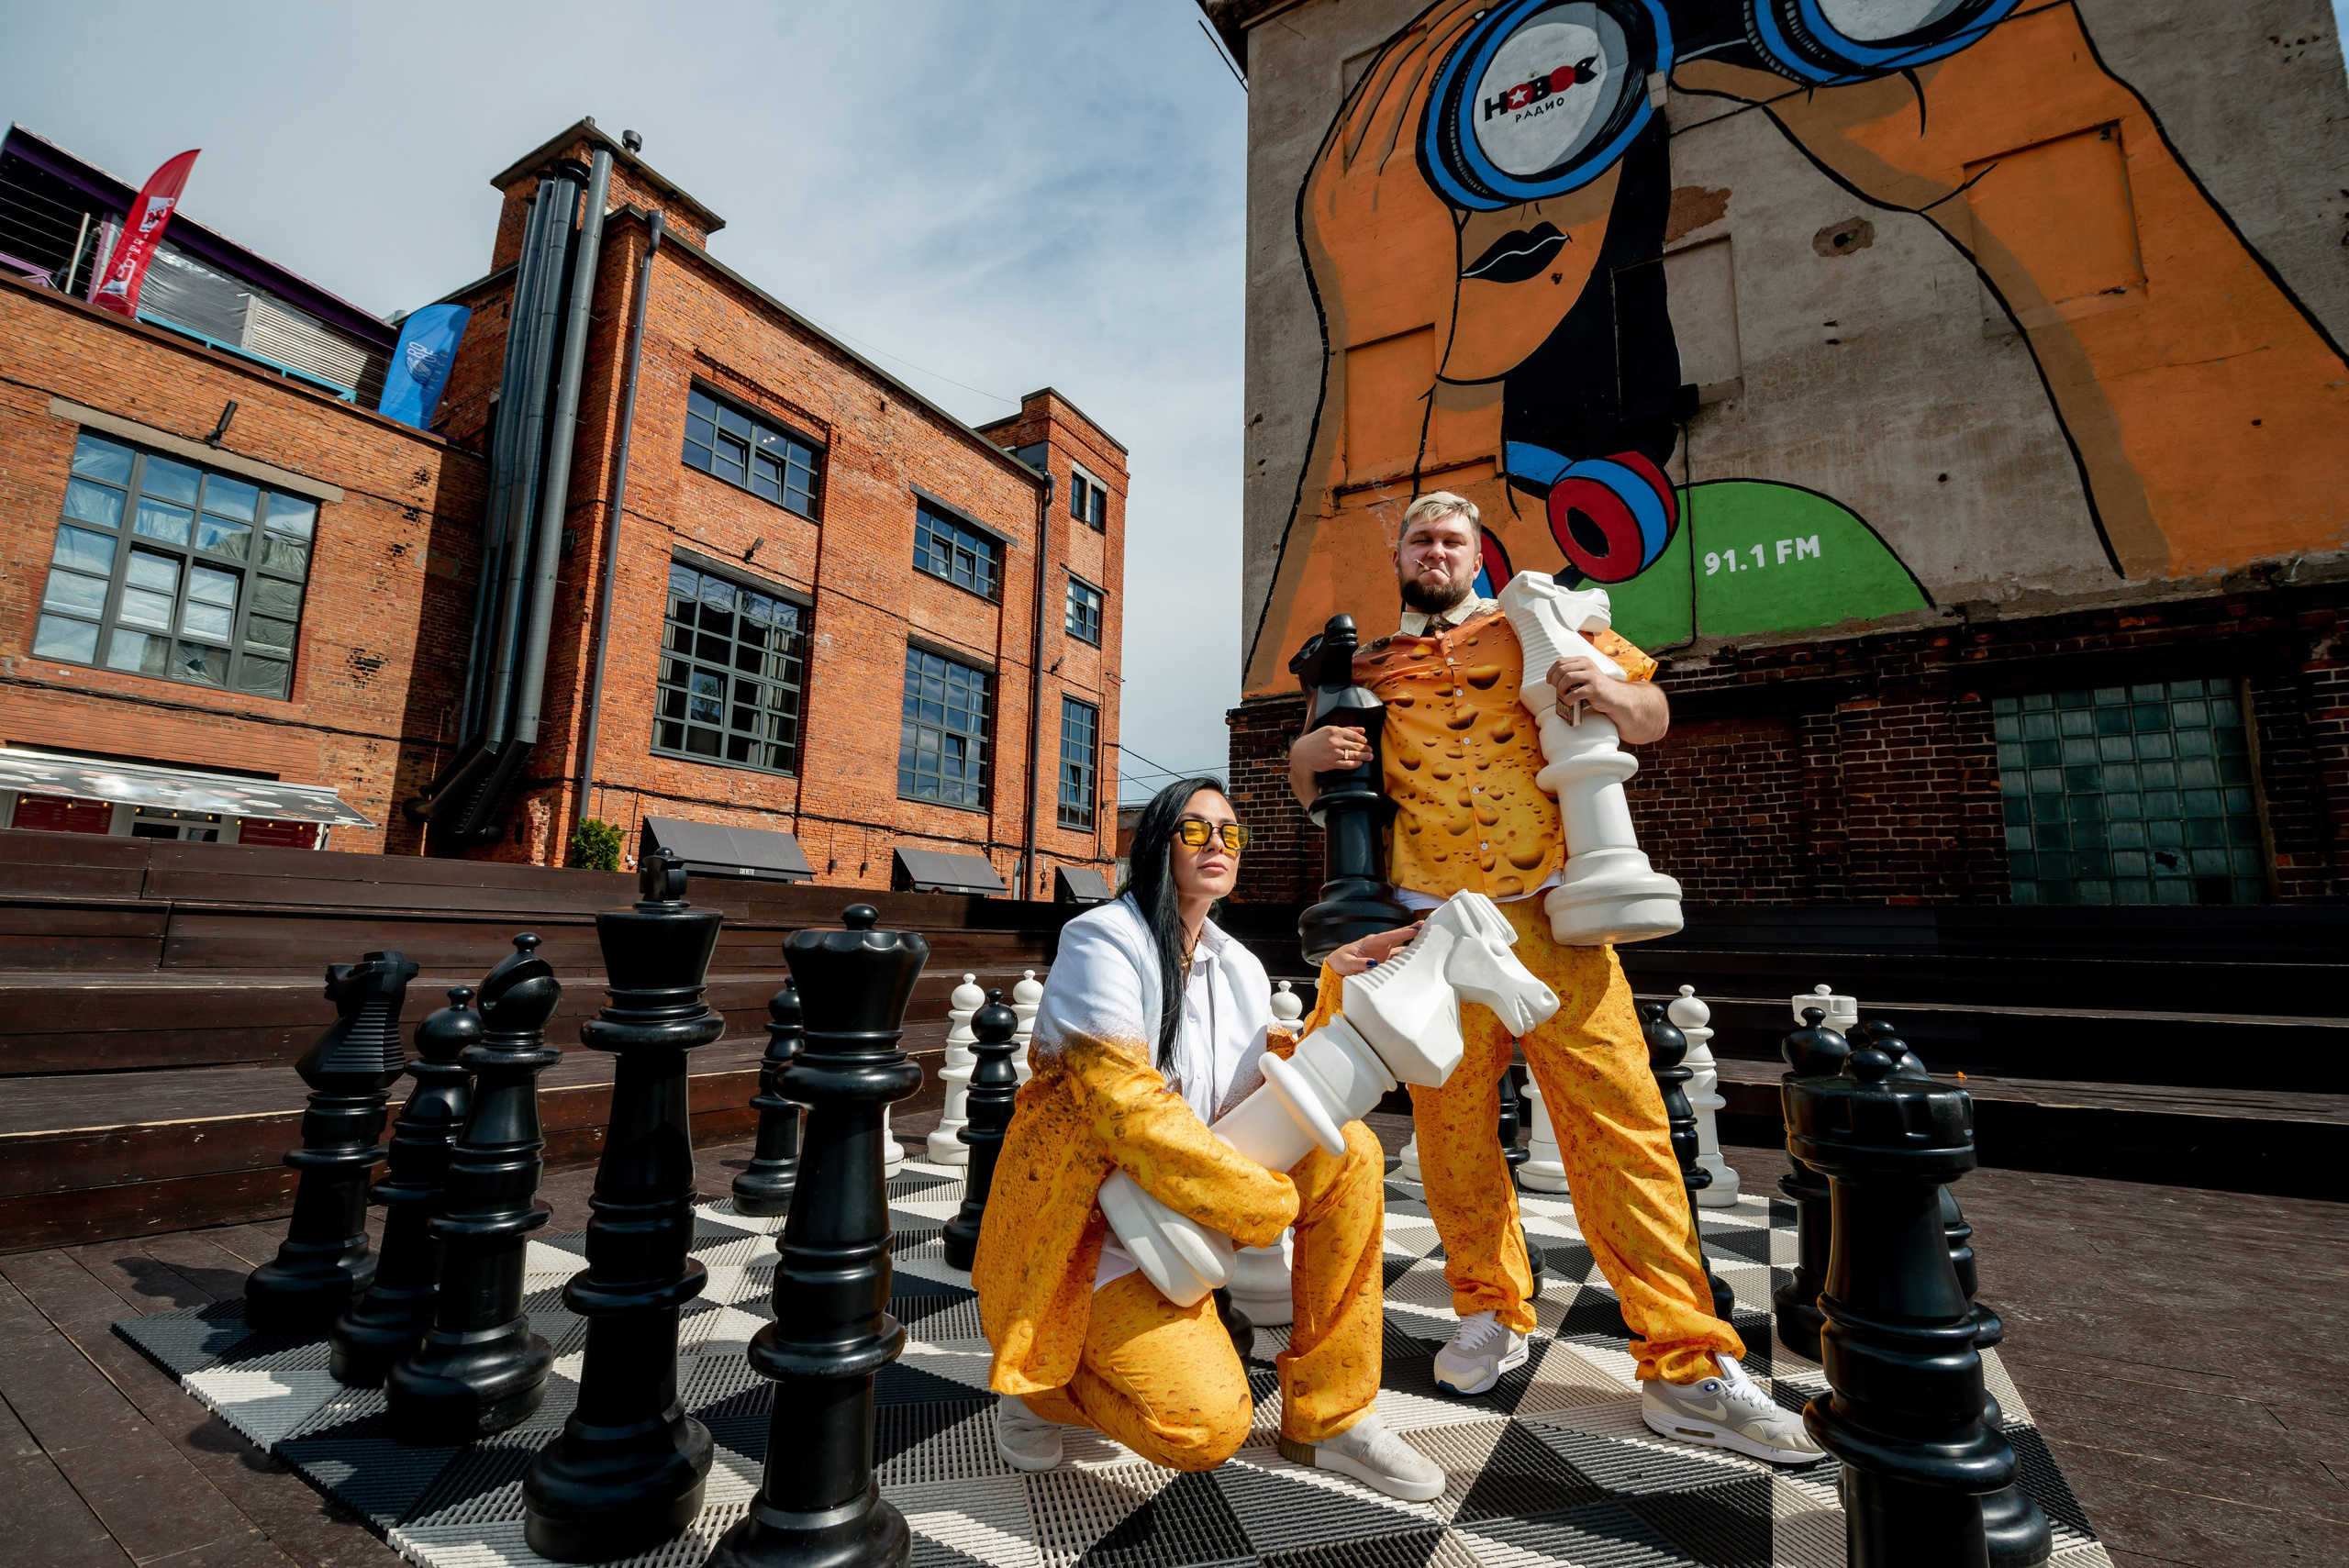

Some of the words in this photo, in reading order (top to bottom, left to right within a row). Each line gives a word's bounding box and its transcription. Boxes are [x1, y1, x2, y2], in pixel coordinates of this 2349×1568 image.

[1515, 96, 1565, 122] РАДИО
[1704, 544, 1765, 576] 91.1
[1776, 535, 1821, 564] FM
